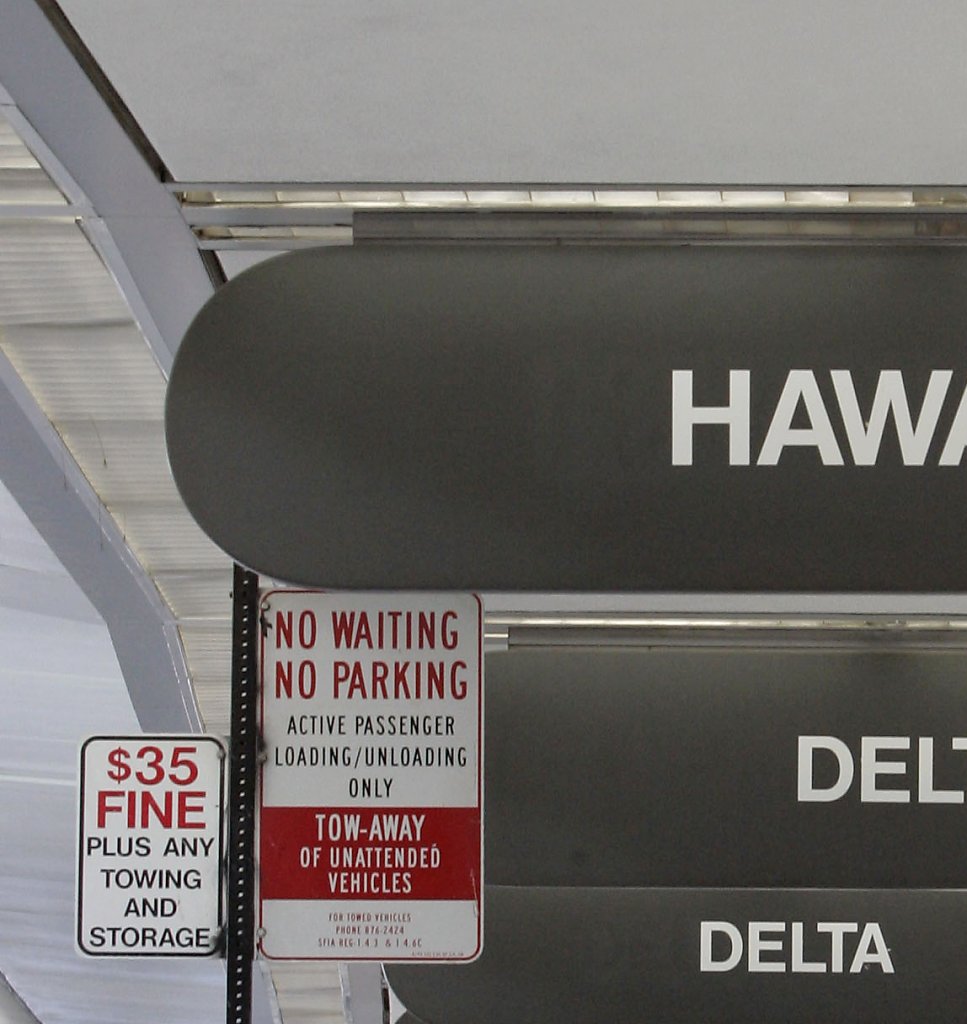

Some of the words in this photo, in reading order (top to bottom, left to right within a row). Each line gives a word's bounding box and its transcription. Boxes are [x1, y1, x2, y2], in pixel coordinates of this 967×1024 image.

[276, 610, 317, 650] NO
[331, 610, 458, 650] WAITING
[275, 660, 316, 700] NO
[333, 660, 468, 700] PARKING
[287, 715, 346, 735] ACTIVE
[355, 715, 455, 736] PASSENGER
[107, 746, 199, 786] $35
[275, 746, 467, 769] LOADING/UNLOADING
[349, 778, 393, 798] ONLY
[97, 791, 206, 829] FINE
[315, 814, 426, 841] TOW-AWAY
[87, 837, 151, 857] PLUS
[163, 837, 215, 857] ANY
[300, 847, 322, 868] OF
[330, 847, 441, 868] UNATTENDED
[100, 869, 201, 889] TOWING
[328, 872, 412, 893] VEHICLES
[124, 898, 177, 917] AND
[328, 912, 344, 922] FOR
[347, 912, 372, 922] TOWED
[375, 912, 412, 923] VEHICLES
[89, 927, 210, 947] STORAGE
[336, 926, 361, 935] PHONE
[700, 921, 894, 974] DELTA
